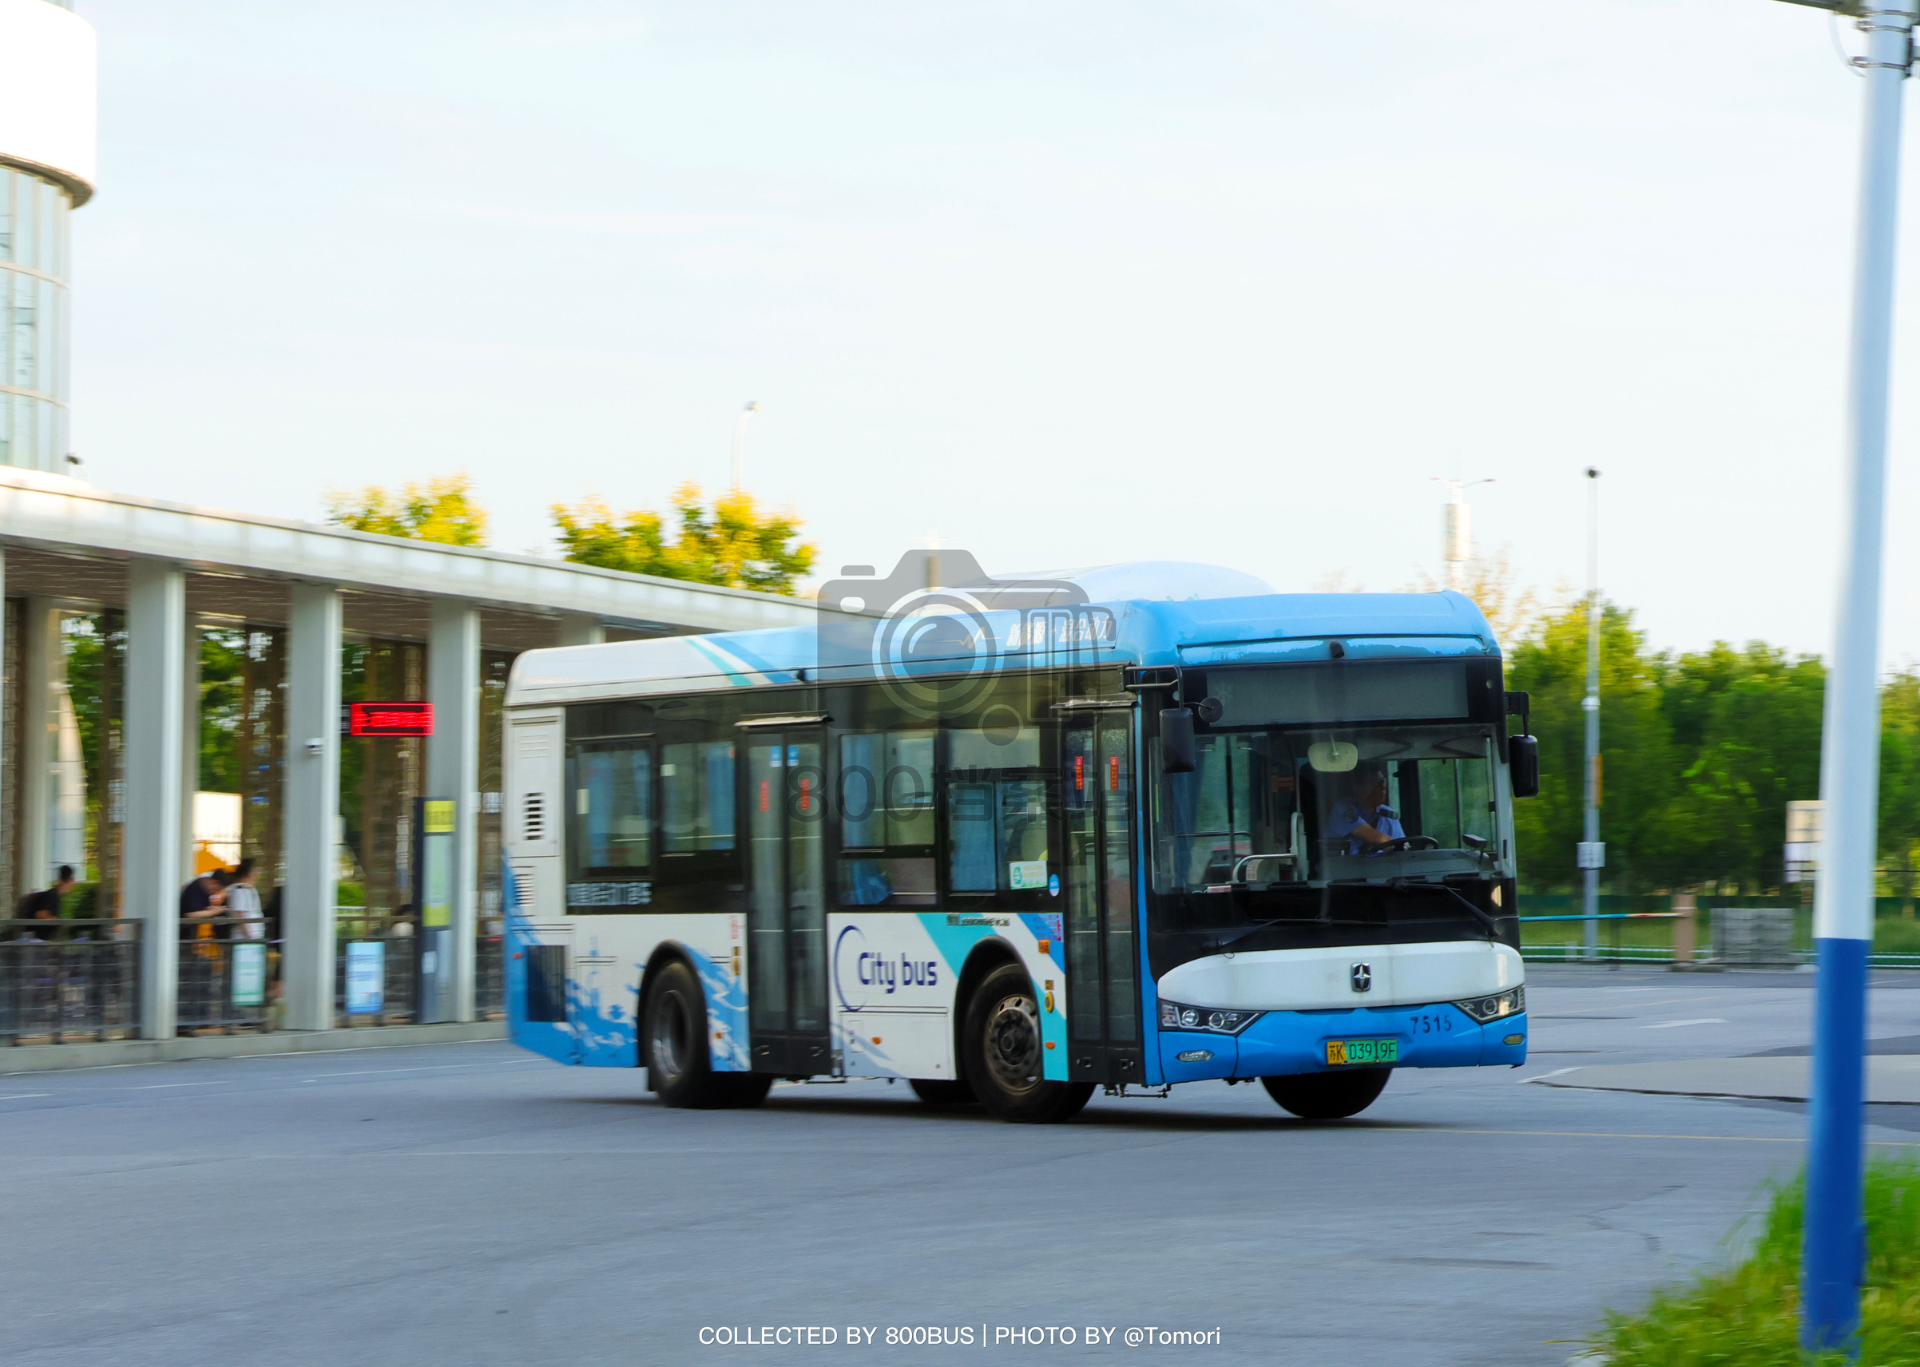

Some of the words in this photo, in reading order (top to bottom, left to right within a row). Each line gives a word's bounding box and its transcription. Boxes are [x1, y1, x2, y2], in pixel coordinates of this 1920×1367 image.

[858, 951, 897, 994] City
[901, 951, 938, 986] bus
[1410, 1014, 1452, 1035] 7515
